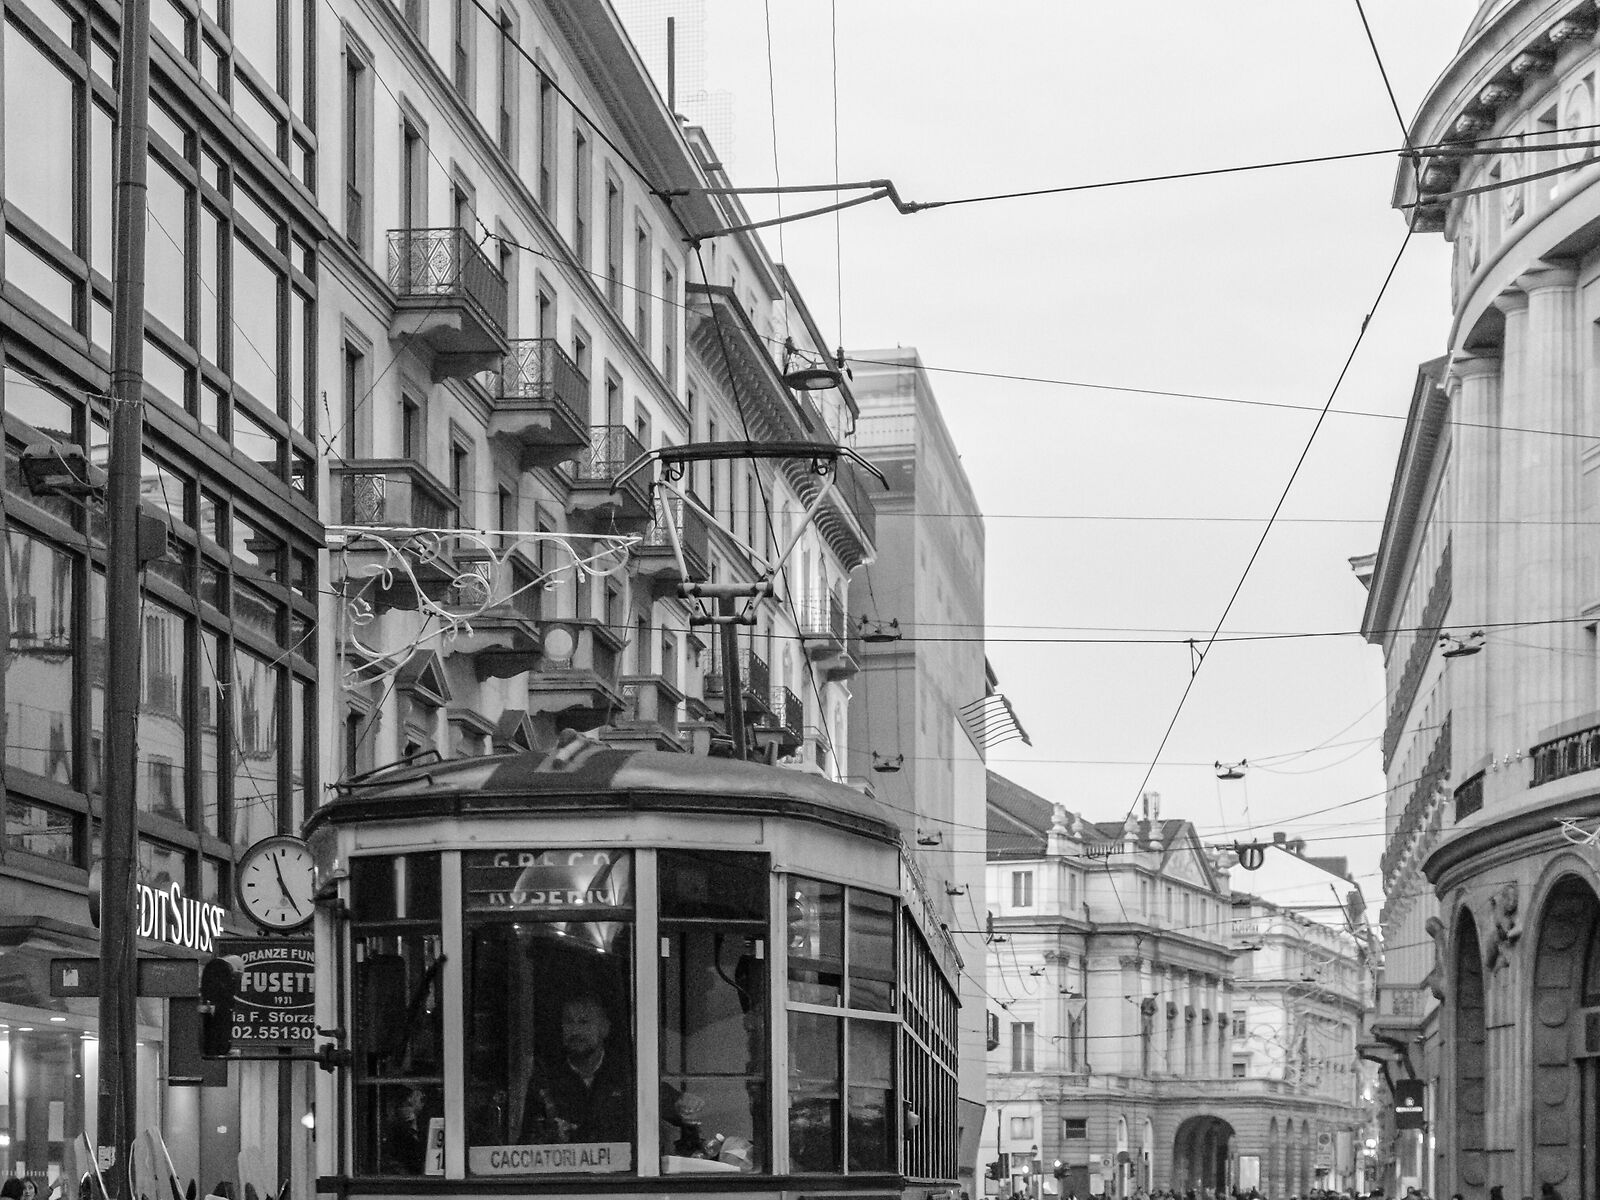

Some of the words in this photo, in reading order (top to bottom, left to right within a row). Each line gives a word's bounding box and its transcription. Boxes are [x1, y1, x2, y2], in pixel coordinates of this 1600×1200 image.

[136, 883, 169, 941] DIT
[274, 996, 293, 1005] 1931
[250, 1011, 263, 1022] F.
[490, 1149, 577, 1169] CACCIATORI
[579, 1147, 611, 1167] ALPI
